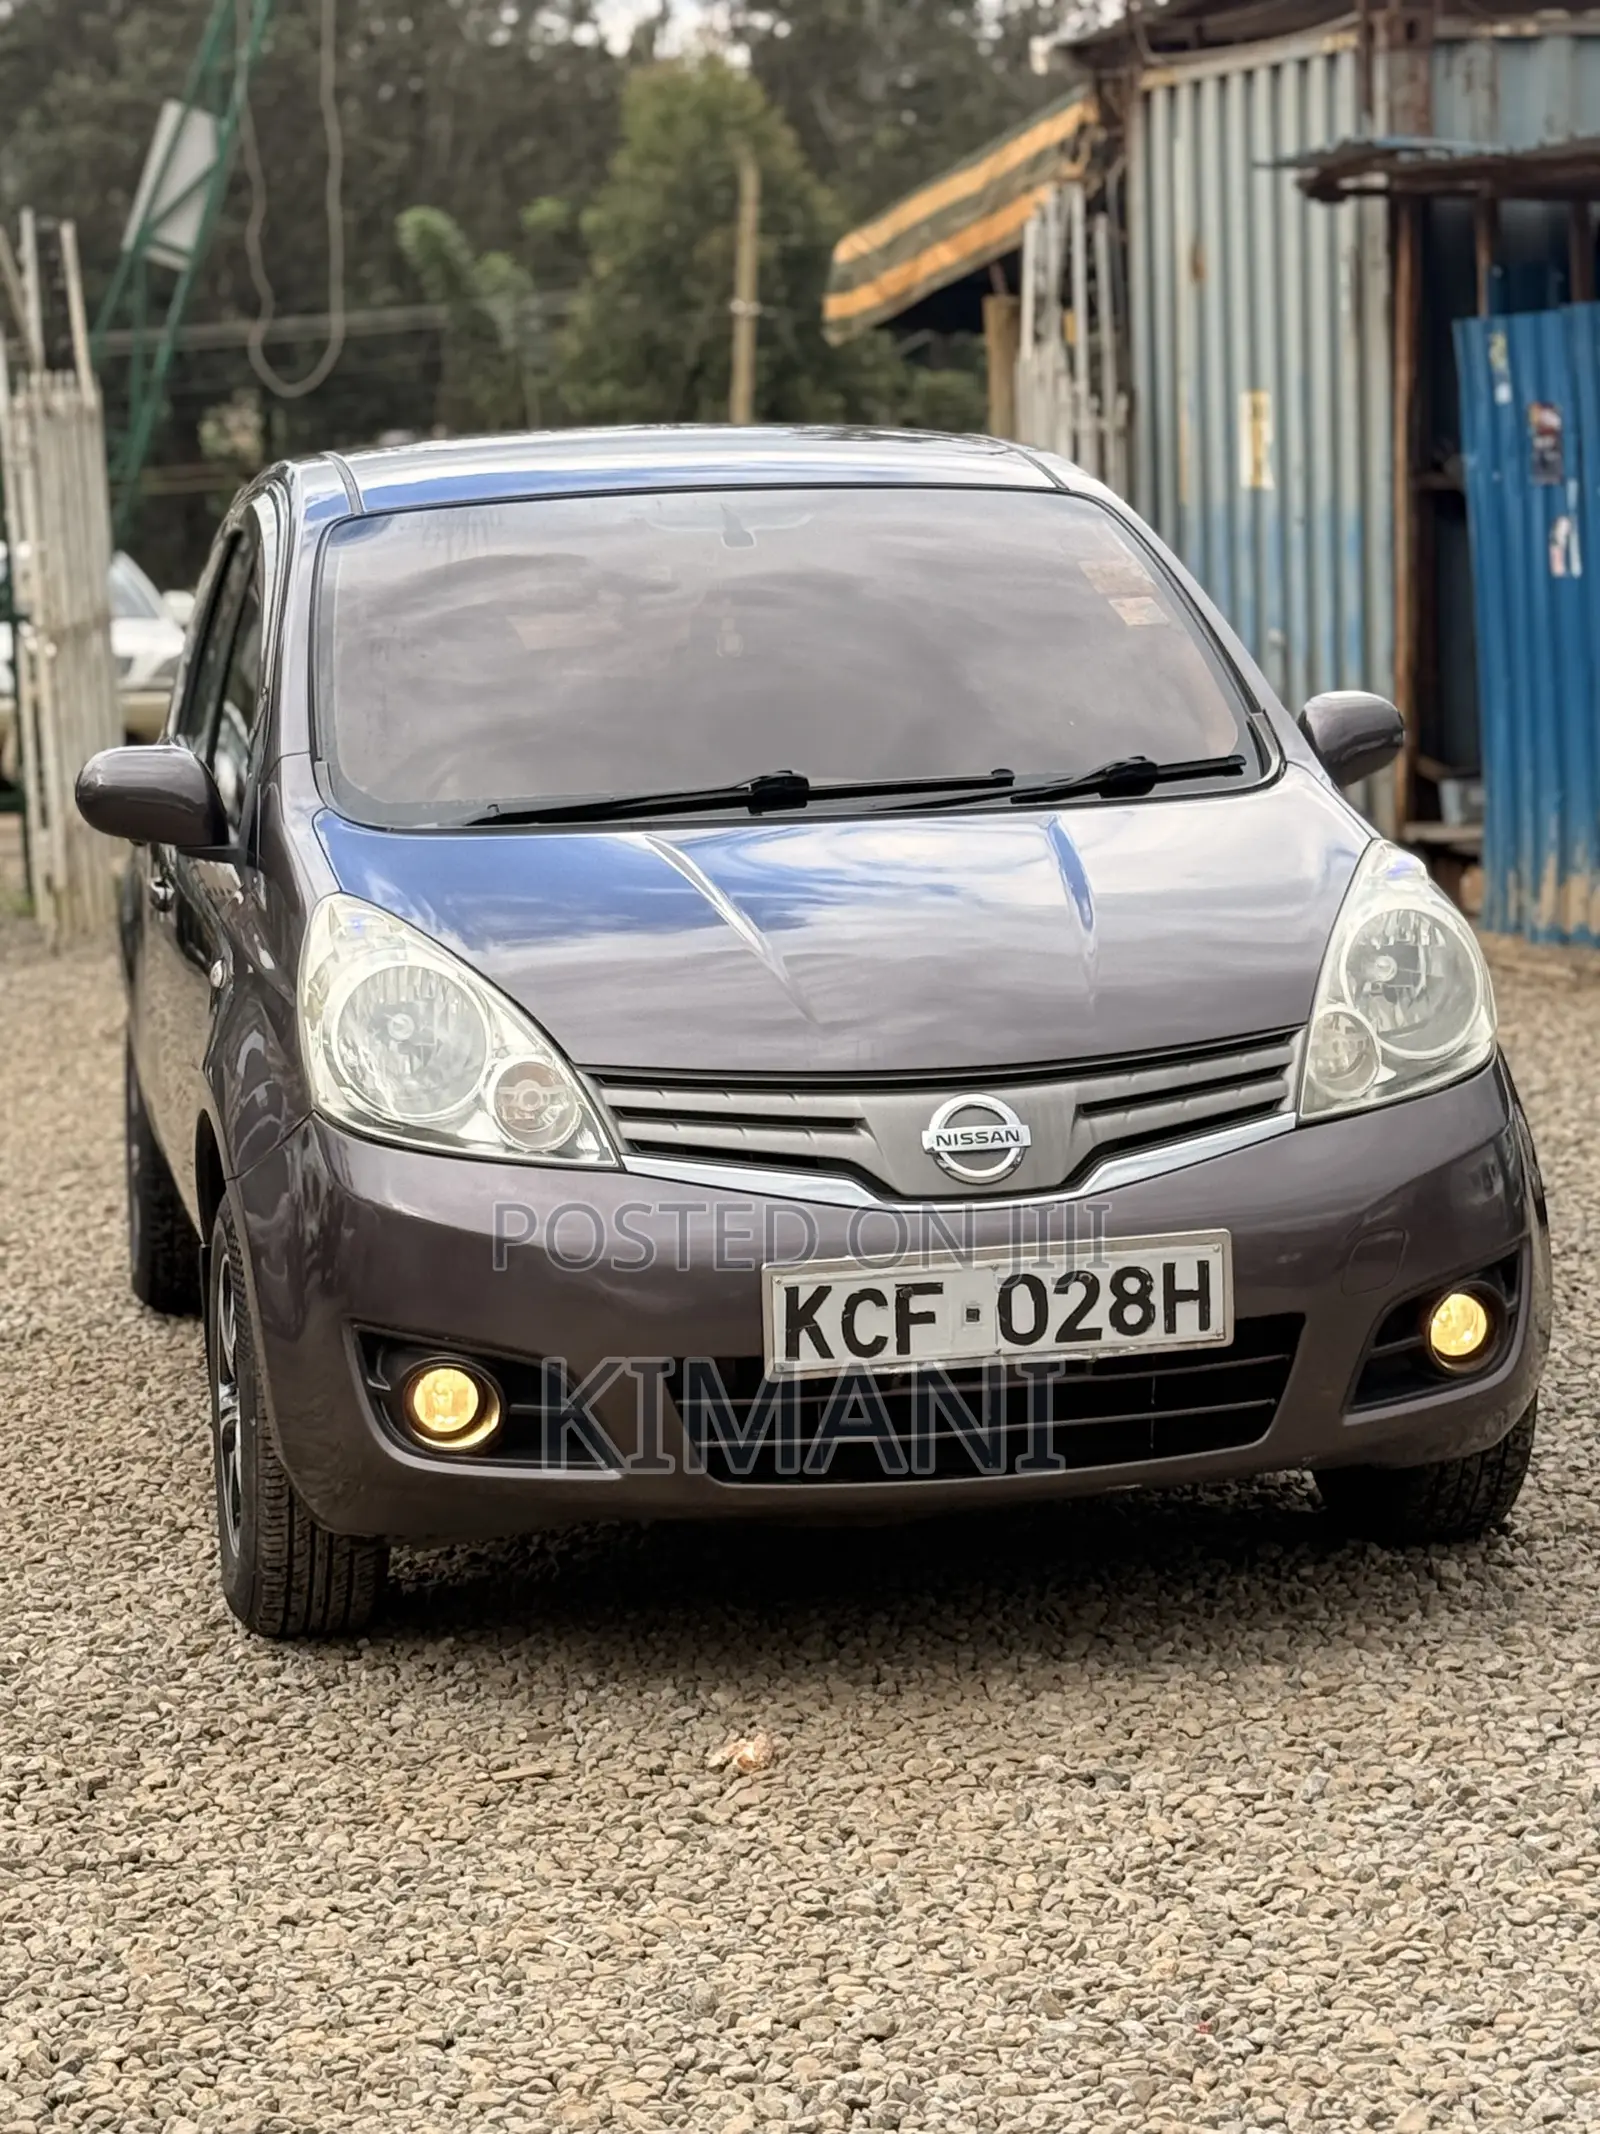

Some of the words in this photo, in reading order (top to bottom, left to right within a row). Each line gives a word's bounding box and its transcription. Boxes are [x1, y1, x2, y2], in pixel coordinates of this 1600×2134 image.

[935, 1129, 1020, 1147] NISSAN
[784, 1281, 944, 1361] KCF
[997, 1260, 1211, 1346] 028H
